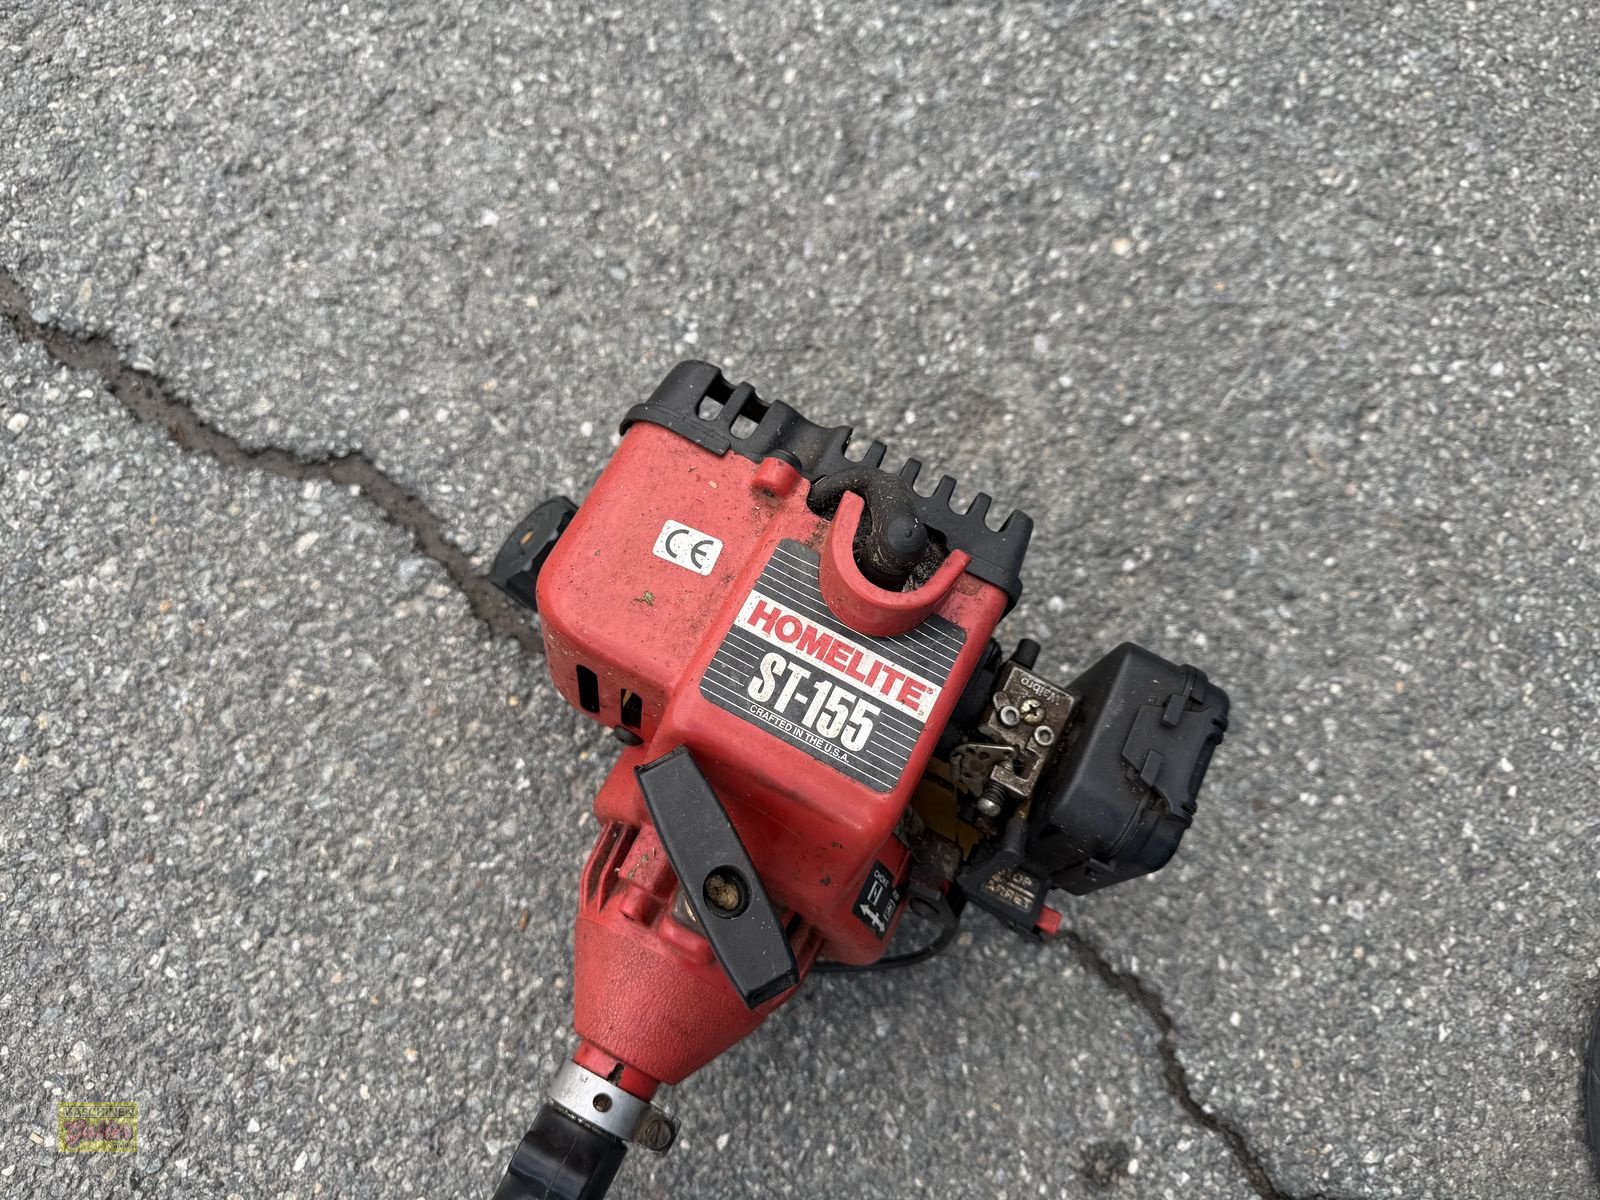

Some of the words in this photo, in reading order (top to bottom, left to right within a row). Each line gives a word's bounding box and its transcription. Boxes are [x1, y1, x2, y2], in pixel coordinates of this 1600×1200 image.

[665, 529, 714, 569] CE
[747, 600, 928, 712] HOMELITE
[747, 652, 882, 753] ST-155
[749, 704, 793, 733] CRAFTED
[794, 727, 803, 737] IN
[804, 731, 823, 750] THE
[824, 741, 850, 763] U.S.A.
